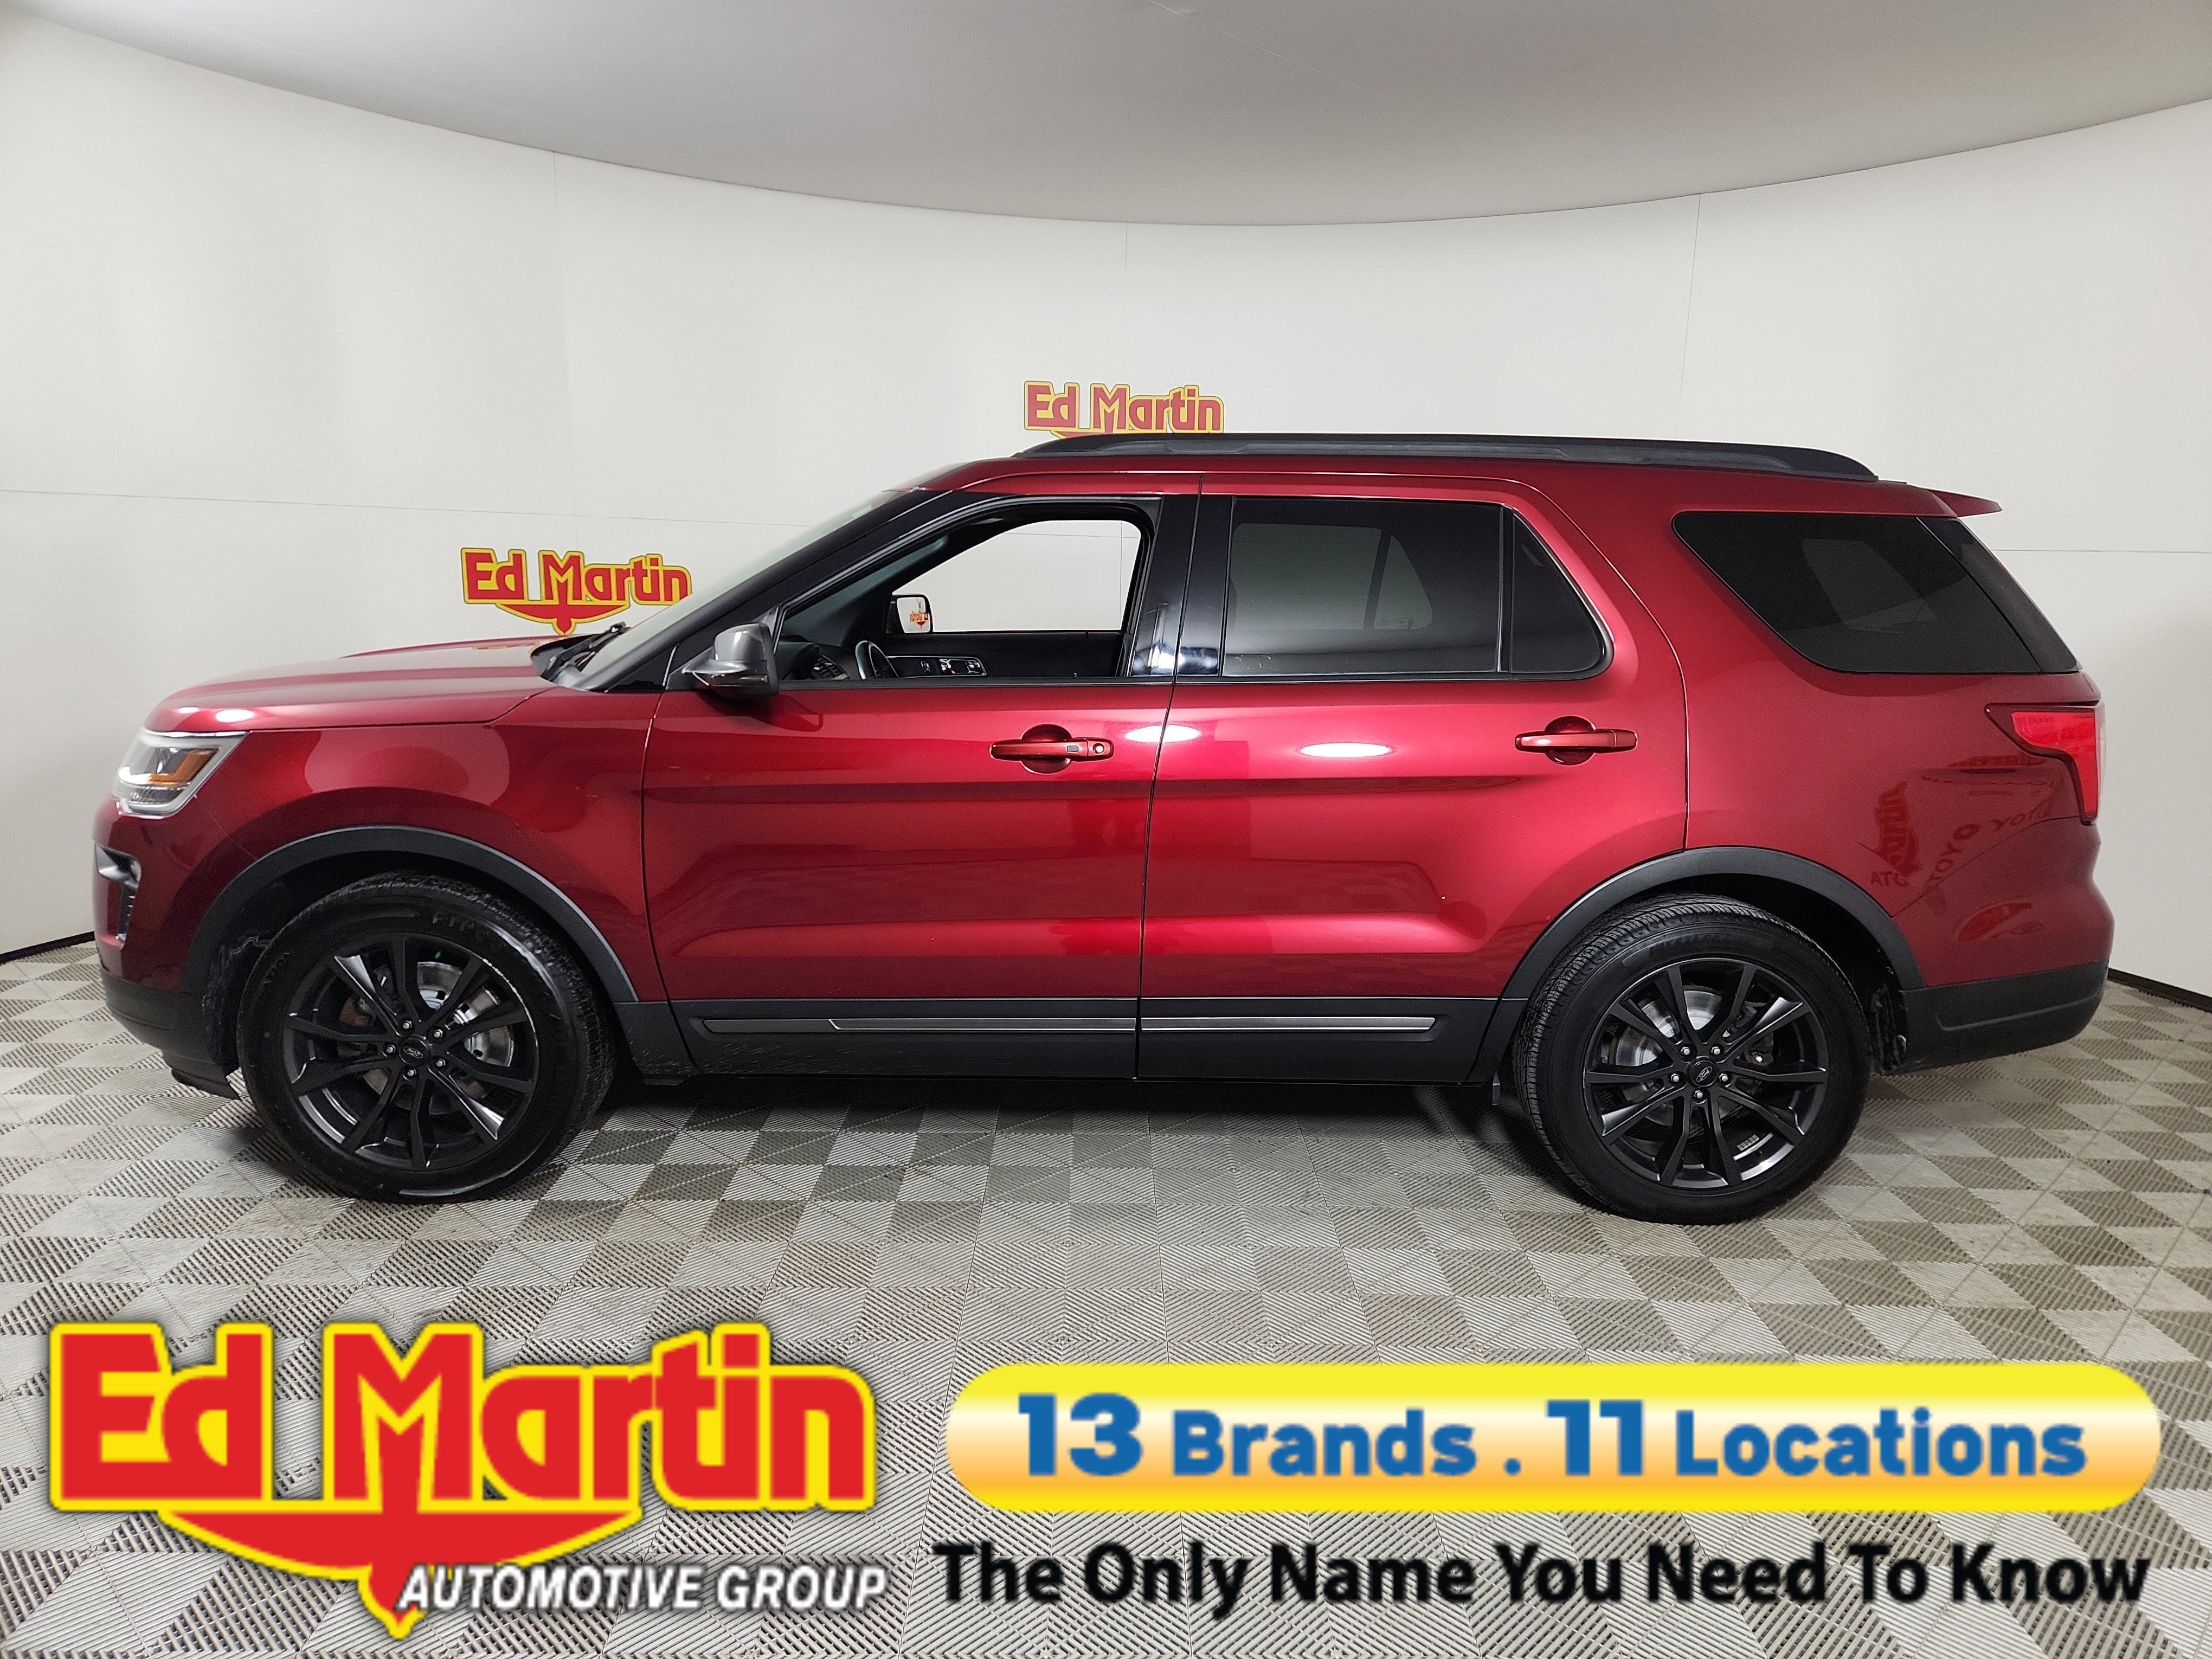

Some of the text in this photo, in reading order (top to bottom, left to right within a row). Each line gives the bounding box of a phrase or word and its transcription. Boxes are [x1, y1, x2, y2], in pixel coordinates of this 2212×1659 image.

[1026, 383, 1222, 433] Ed Martin
[462, 550, 692, 604] Ed Martin
